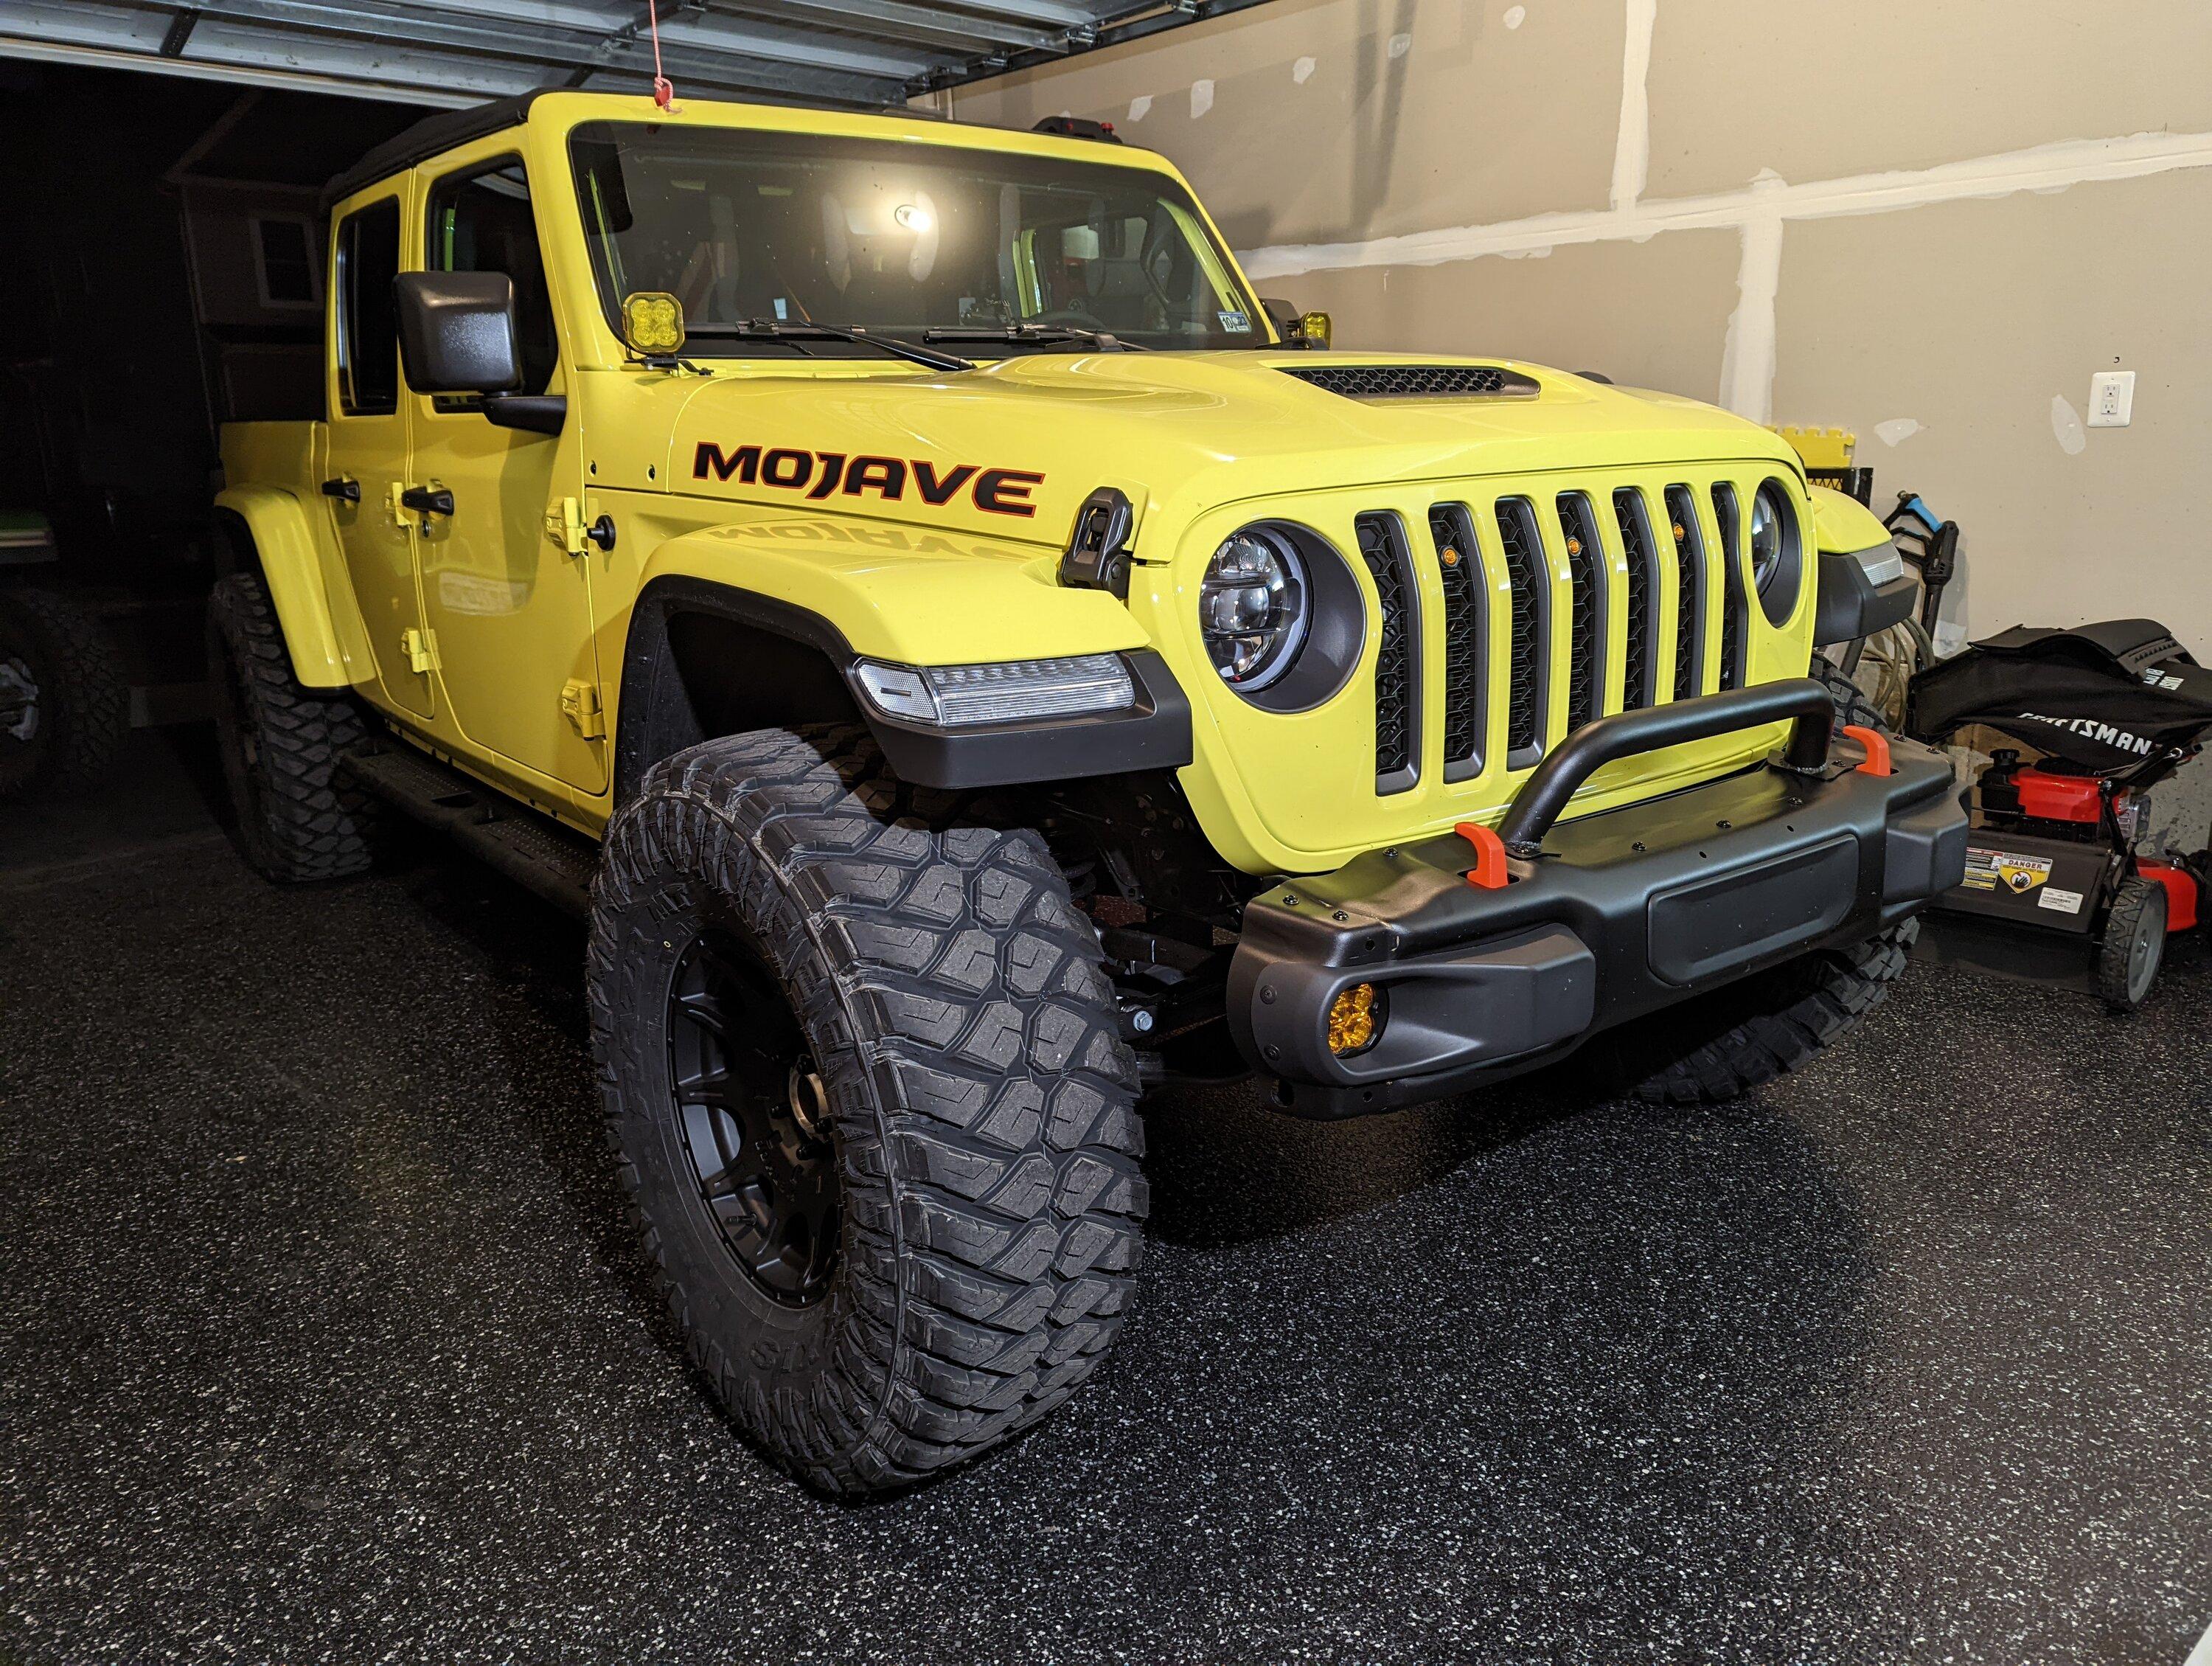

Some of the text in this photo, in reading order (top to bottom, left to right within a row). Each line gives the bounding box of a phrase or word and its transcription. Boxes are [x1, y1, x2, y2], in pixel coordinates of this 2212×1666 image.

[1222, 316, 1234, 329] 10
[692, 440, 1046, 518] MOJAVE
[2008, 860, 2042, 870] DANGER
